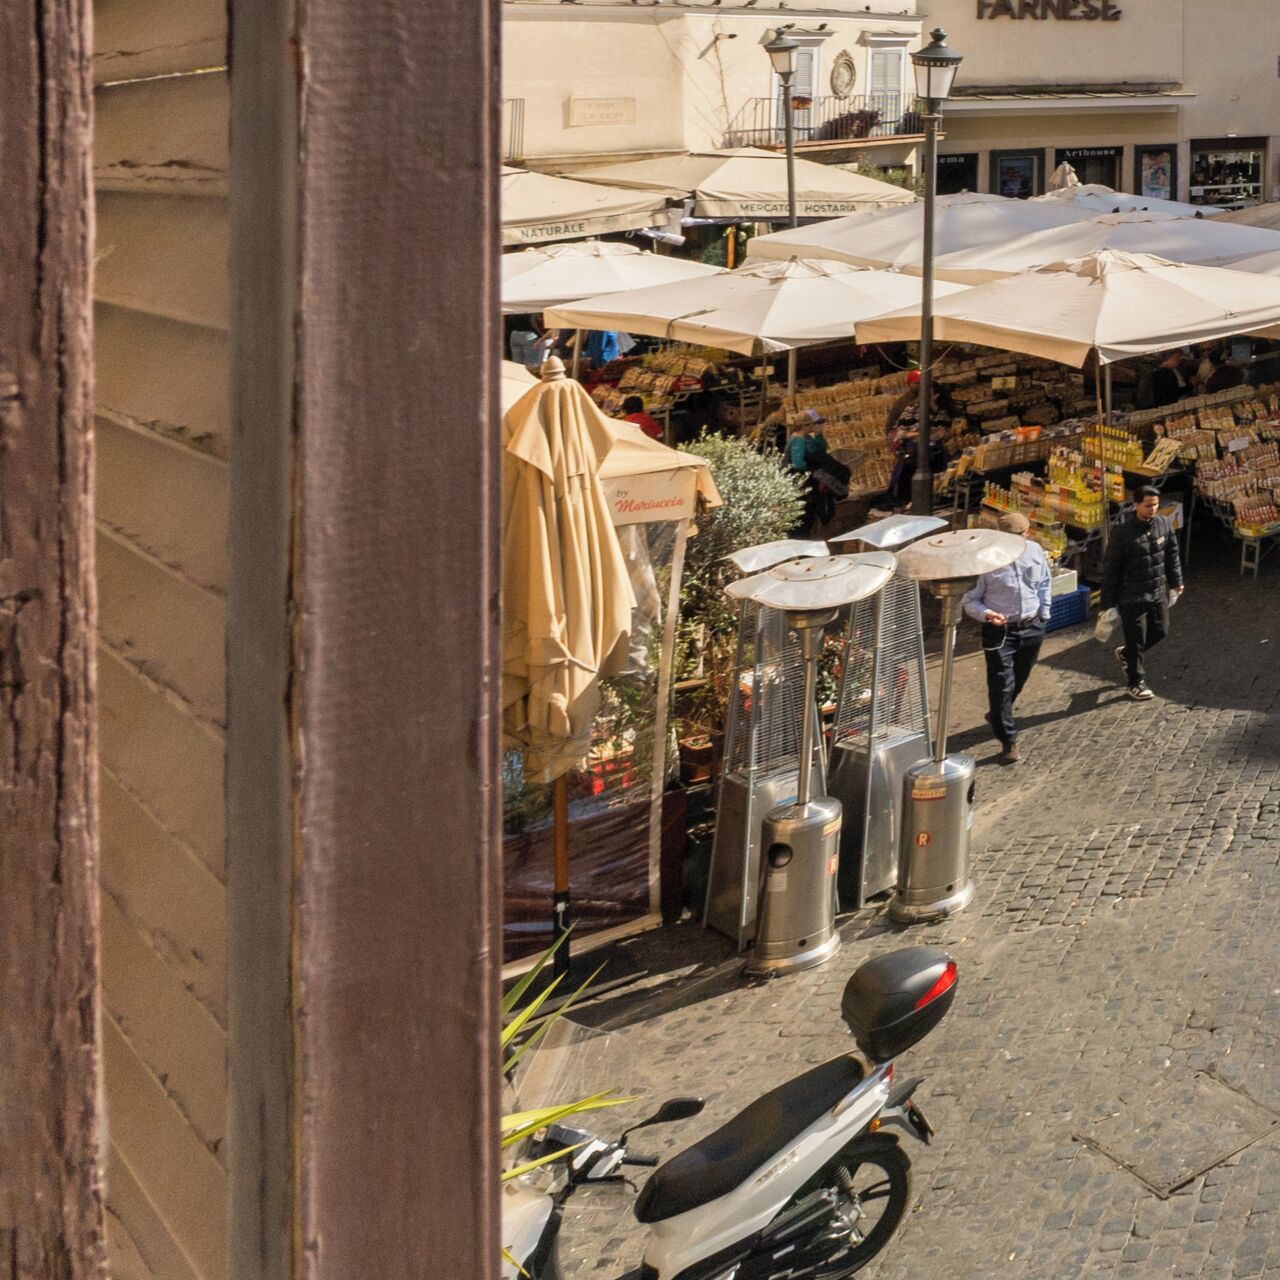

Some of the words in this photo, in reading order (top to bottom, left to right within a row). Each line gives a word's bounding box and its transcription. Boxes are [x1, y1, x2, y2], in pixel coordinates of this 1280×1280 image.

[1064, 149, 1116, 157] Arthouse
[939, 156, 965, 164] ema
[739, 203, 791, 214] MERCATO
[804, 203, 857, 213] HOSTARIA
[520, 222, 587, 240] NATURALE
[616, 489, 630, 498] by
[919, 833, 928, 846] R
